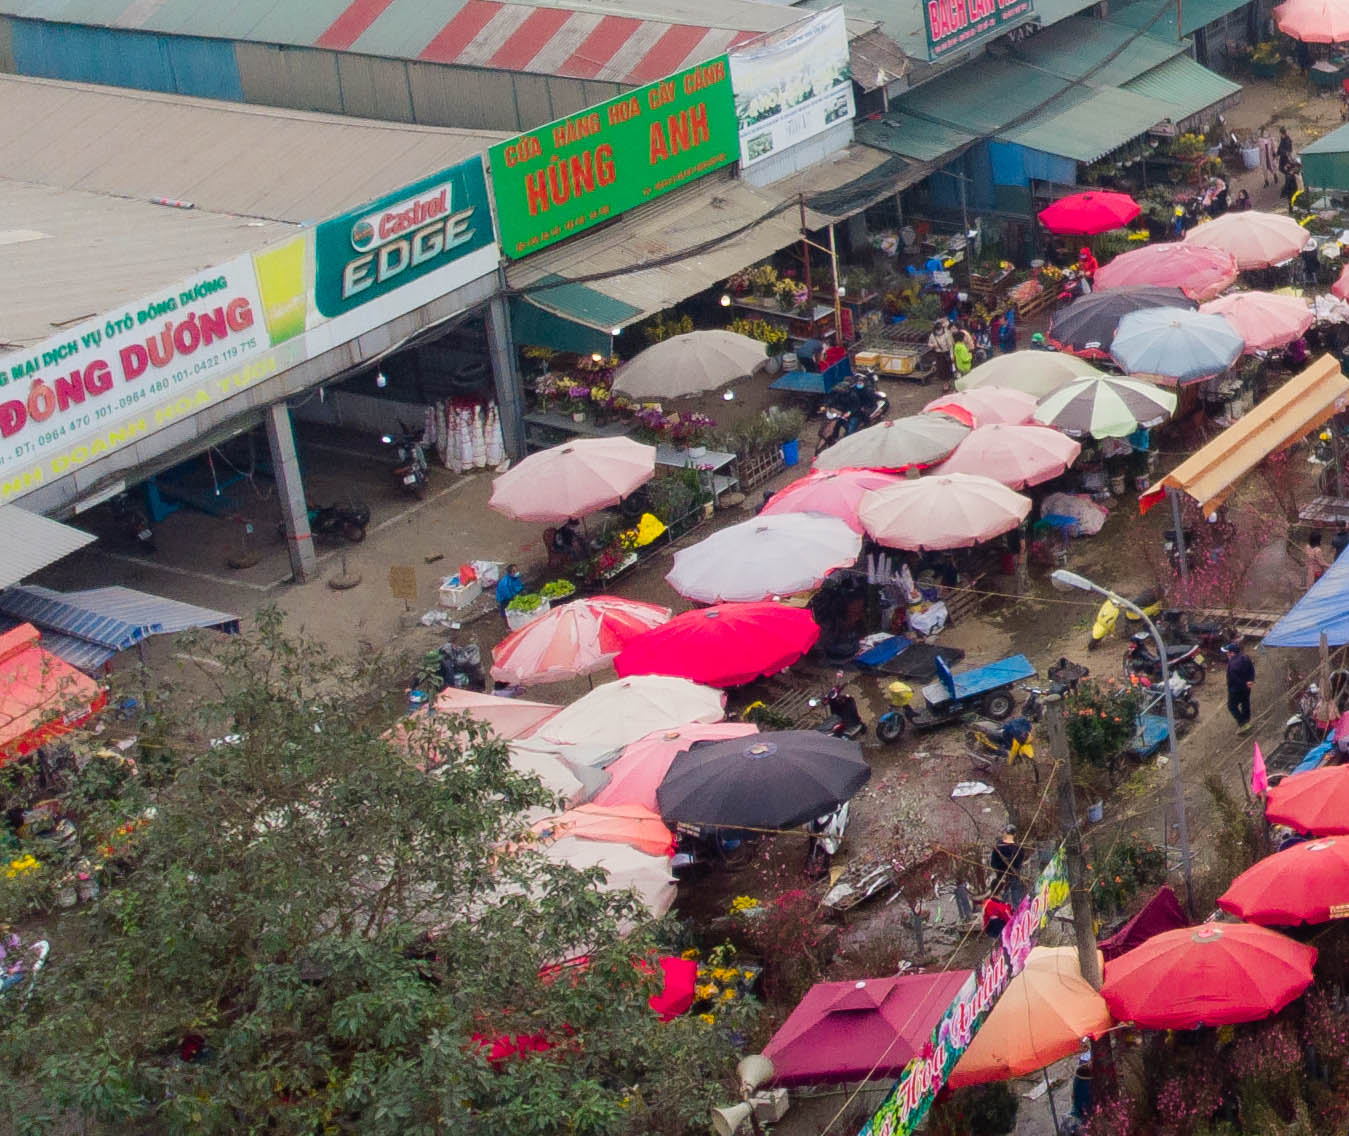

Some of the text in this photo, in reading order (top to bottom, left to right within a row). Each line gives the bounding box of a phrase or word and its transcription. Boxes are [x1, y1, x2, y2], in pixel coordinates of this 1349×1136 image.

[503, 61, 726, 169] CỬA HÀNG HOA CÂY CẢNH
[524, 143, 617, 217] HÙNG
[650, 102, 710, 166] ANH
[342, 207, 477, 301] EDGE
[378, 188, 449, 240] Castrol
[0, 296, 255, 439] ĐÔNG DƯƠNG
[11, 275, 228, 379] MẠI DỊCH VỤ ÔTÔ ĐÔNG DƯƠNG
[37, 426, 67, 448] 0964
[150, 377, 170, 396] 480
[222, 347, 239, 365] 119
[50, 416, 149, 476] DOANH
[154, 388, 211, 424] HOA
[216, 356, 278, 394] TƯƠI
[1008, 879, 1051, 961] 2021
